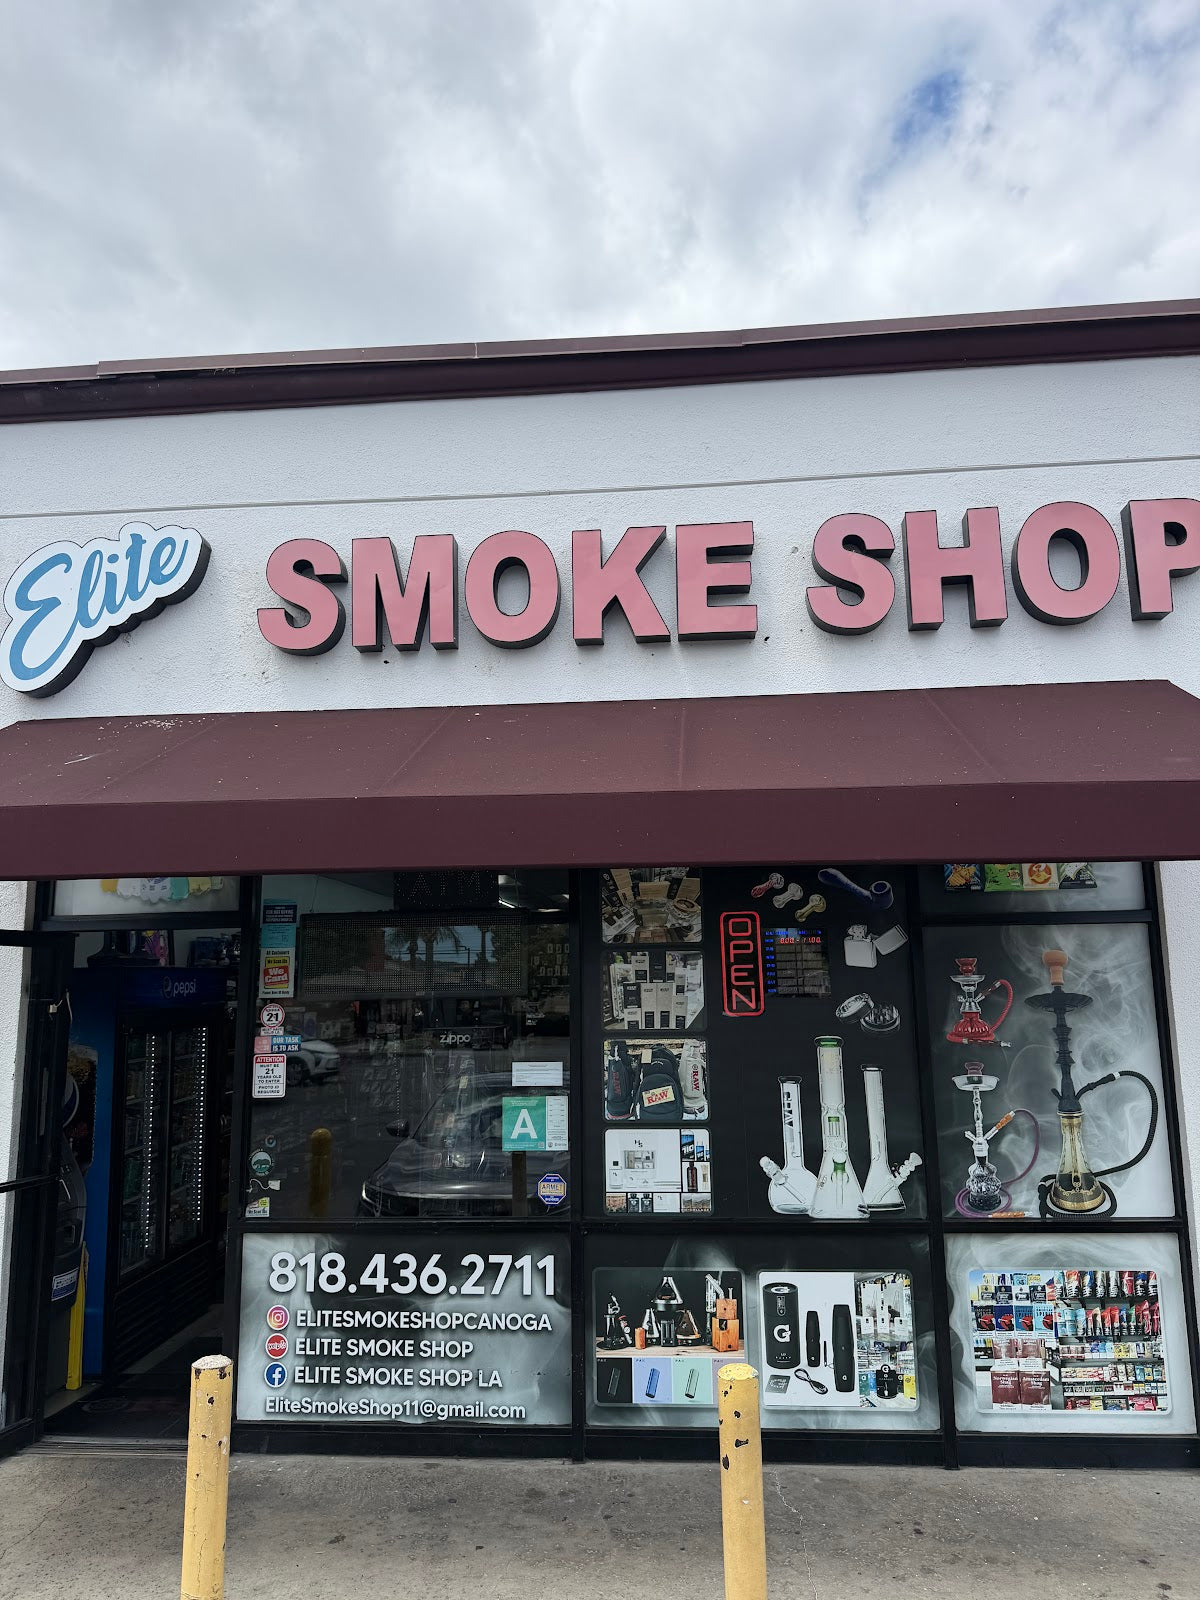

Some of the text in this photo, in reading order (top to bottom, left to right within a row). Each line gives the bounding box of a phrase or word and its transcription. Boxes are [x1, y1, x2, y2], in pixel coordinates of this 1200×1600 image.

[257, 498, 1200, 655] SMOKE SHOP
[9, 533, 189, 681] Elite
[268, 967, 284, 976] We
[728, 918, 756, 1010] OPEN
[173, 979, 196, 997] pepsi
[264, 973, 288, 984] Card
[266, 1012, 279, 1022] 21
[440, 1031, 470, 1044] zippo
[692, 1071, 700, 1092] RAW
[647, 1090, 669, 1105] RAW
[510, 1108, 538, 1139] A
[268, 1251, 556, 1296] 818.436.2711
[296, 1309, 552, 1331] ELITESMOKESHOPCANOGA
[295, 1338, 474, 1358] ELITE SMOKE SHOP
[294, 1366, 503, 1388] ELITE SMOKE SHOP LA
[265, 1396, 527, 1420] EliteSmokeShop11@gmail.com
